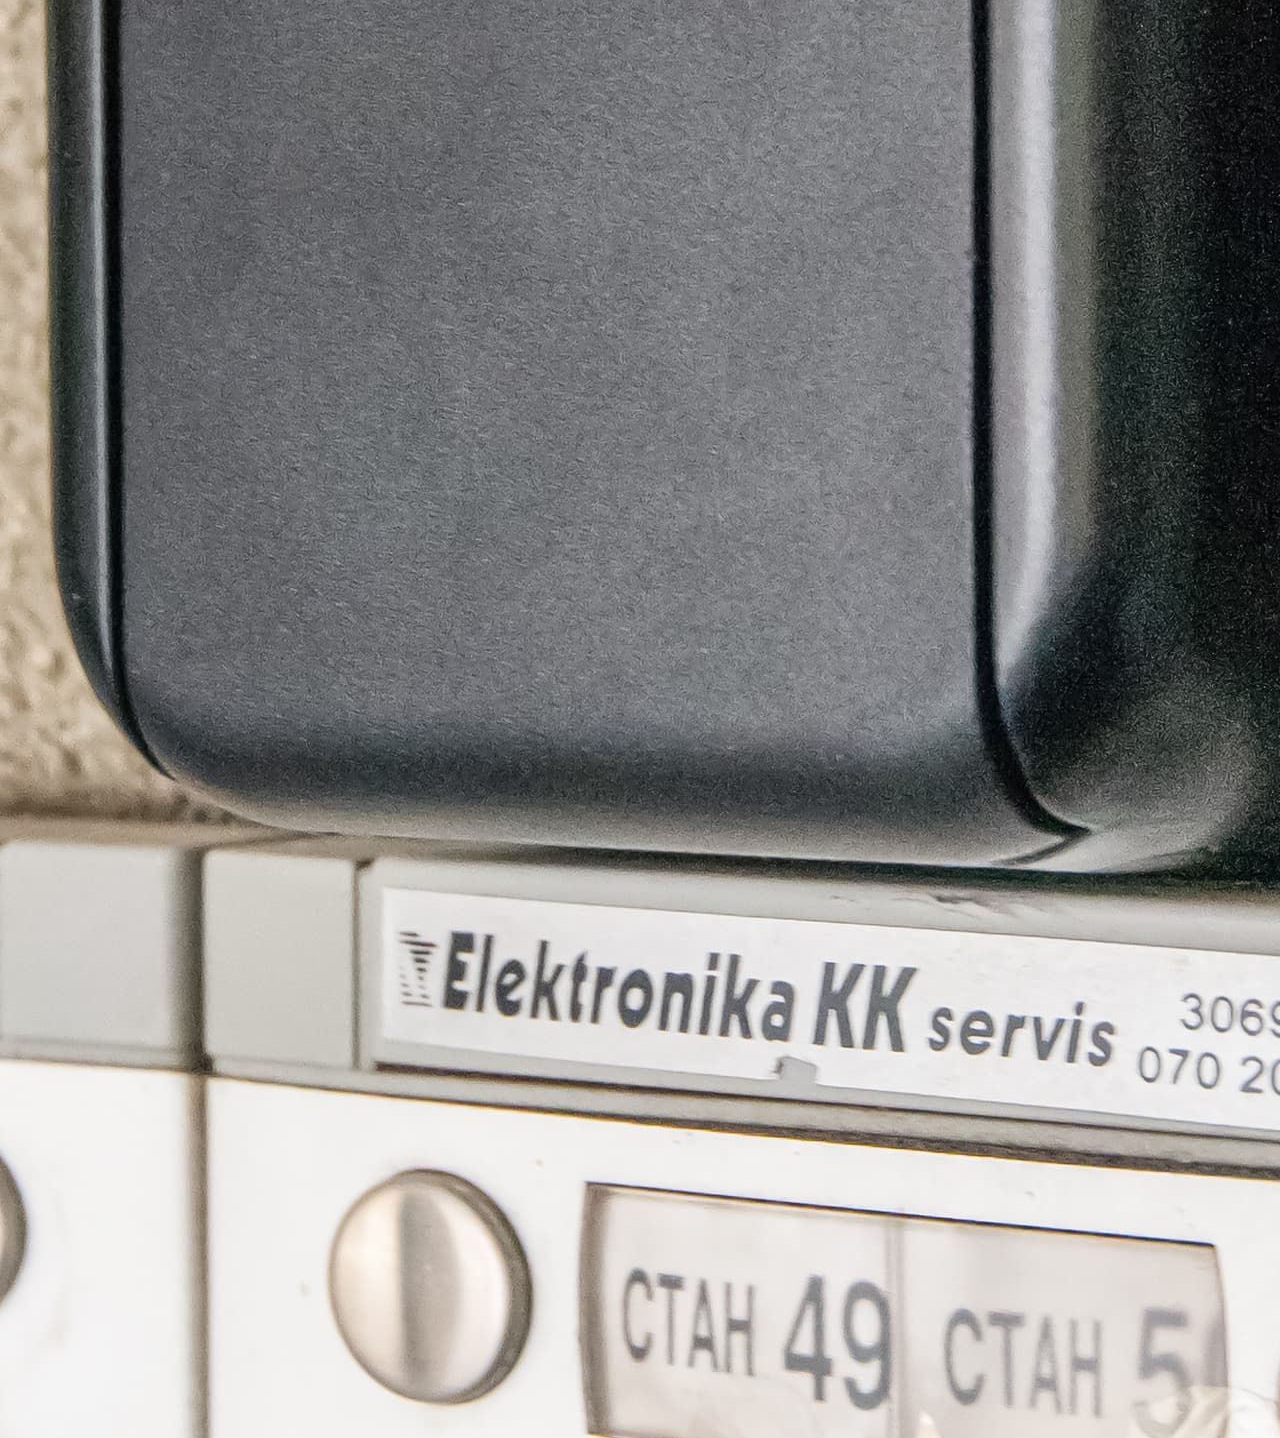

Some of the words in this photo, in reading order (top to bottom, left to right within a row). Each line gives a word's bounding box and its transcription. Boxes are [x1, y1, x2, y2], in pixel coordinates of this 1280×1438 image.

[442, 931, 795, 1042] Elektronika
[812, 961, 917, 1052] KK
[927, 1001, 1116, 1067] servis
[1138, 1046, 1220, 1089] 070
[622, 1268, 756, 1377] СТАН
[783, 1274, 891, 1410] 49
[942, 1308, 1103, 1419] СТАН
